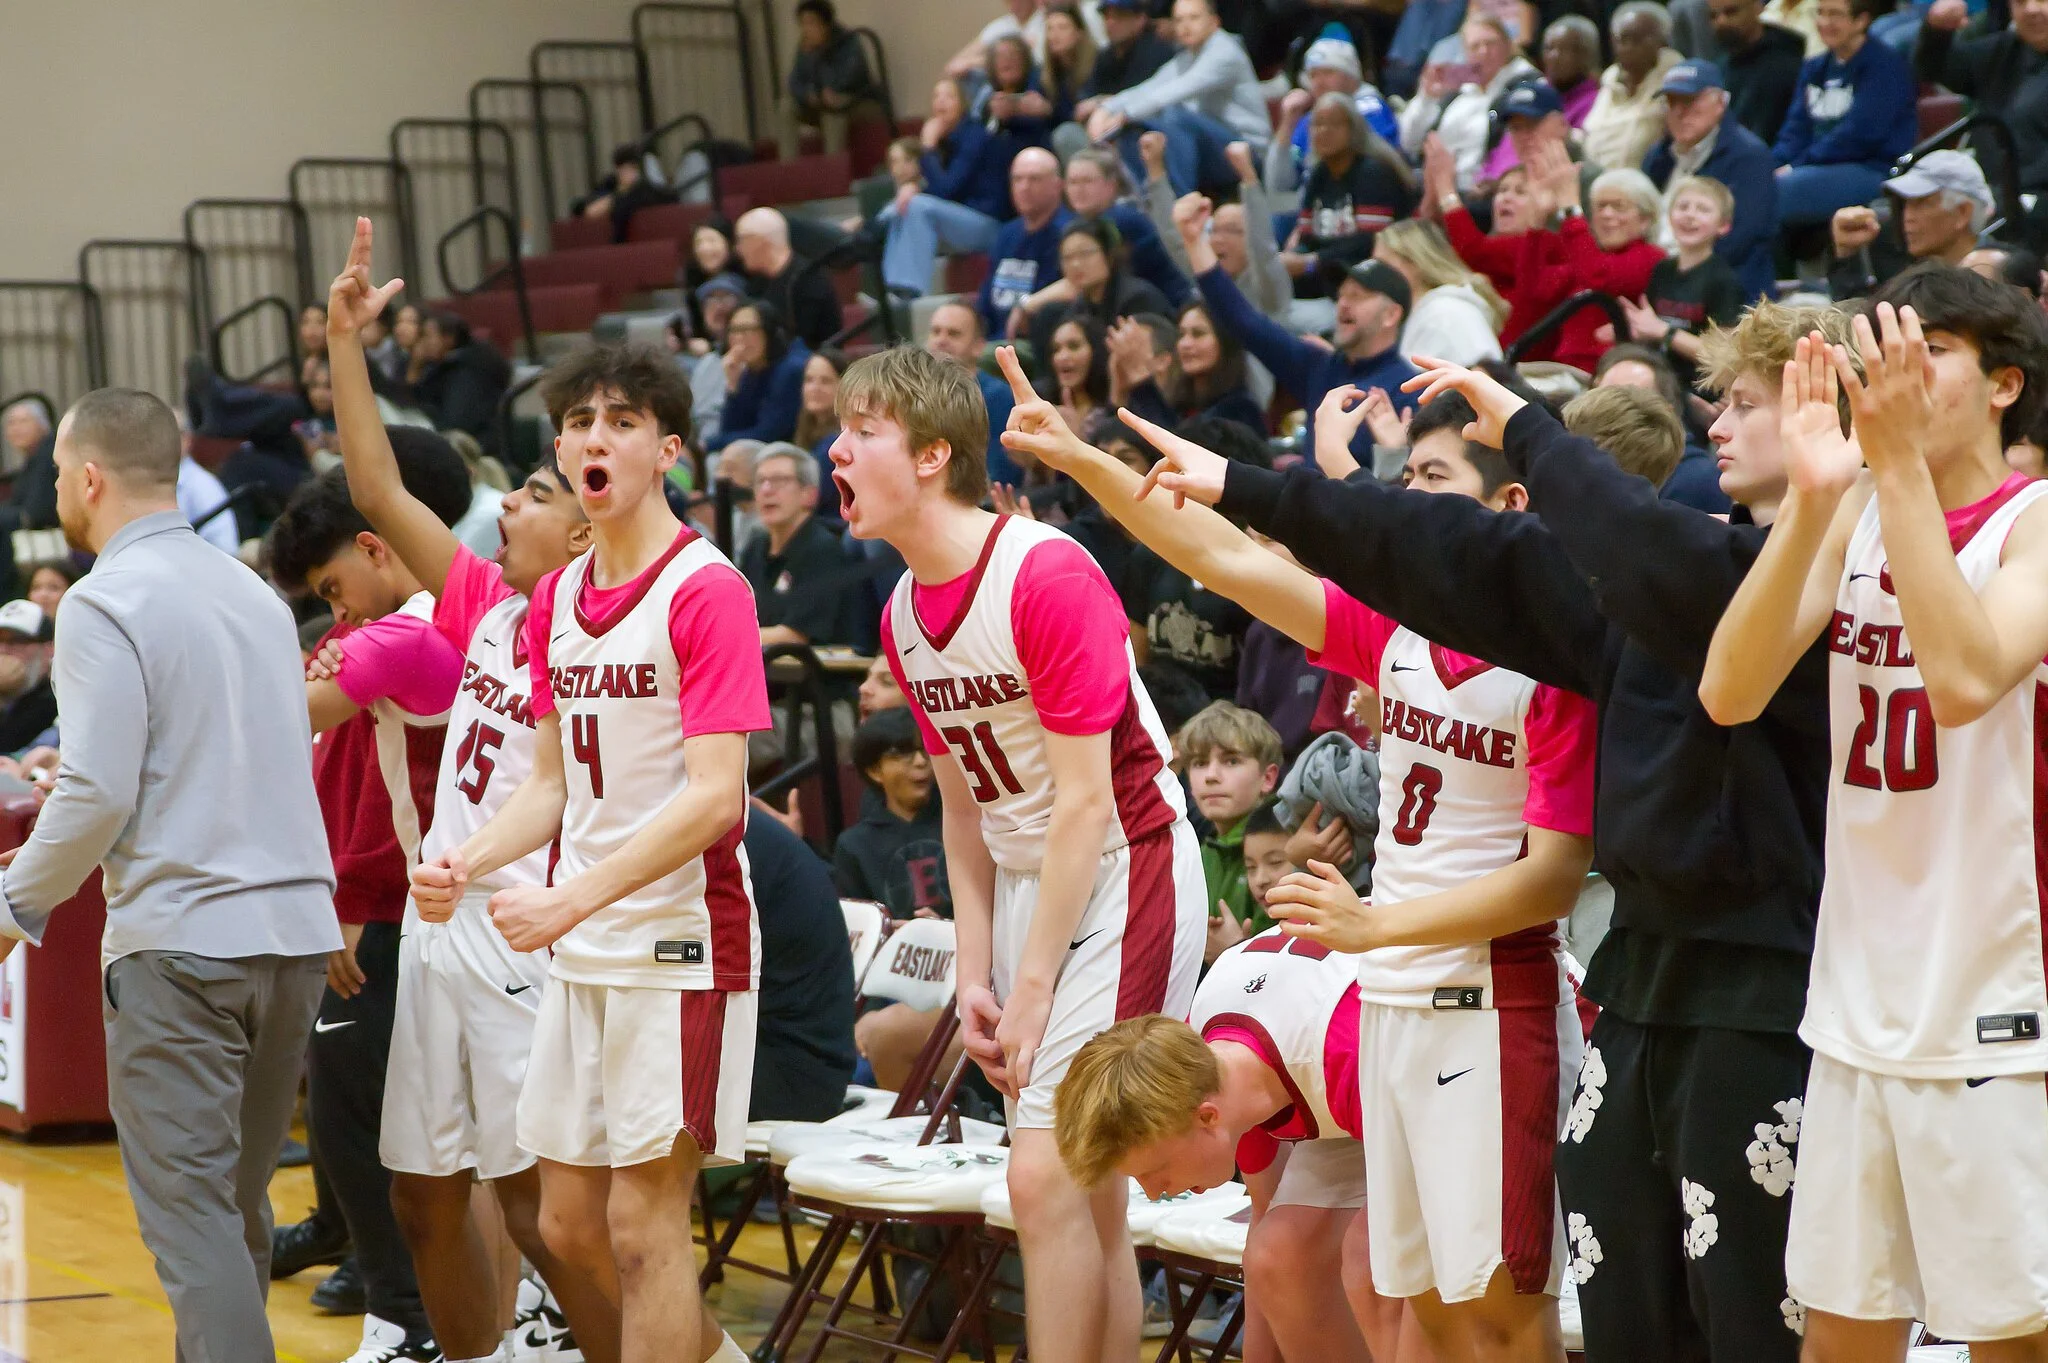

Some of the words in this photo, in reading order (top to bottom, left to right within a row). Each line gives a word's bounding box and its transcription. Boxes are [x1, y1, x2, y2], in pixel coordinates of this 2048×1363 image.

[907, 673, 1028, 713] ASTLAKE
[455, 718, 506, 805] 15
[571, 713, 604, 799] 4
[941, 720, 1026, 803] 31
[1382, 696, 1516, 769] EASTLAKE
[1843, 683, 1939, 792] 20
[1392, 761, 1443, 846] 0
[688, 947, 697, 957] M
[1465, 993, 1473, 1003] S
[2021, 1020, 2030, 1032] L
